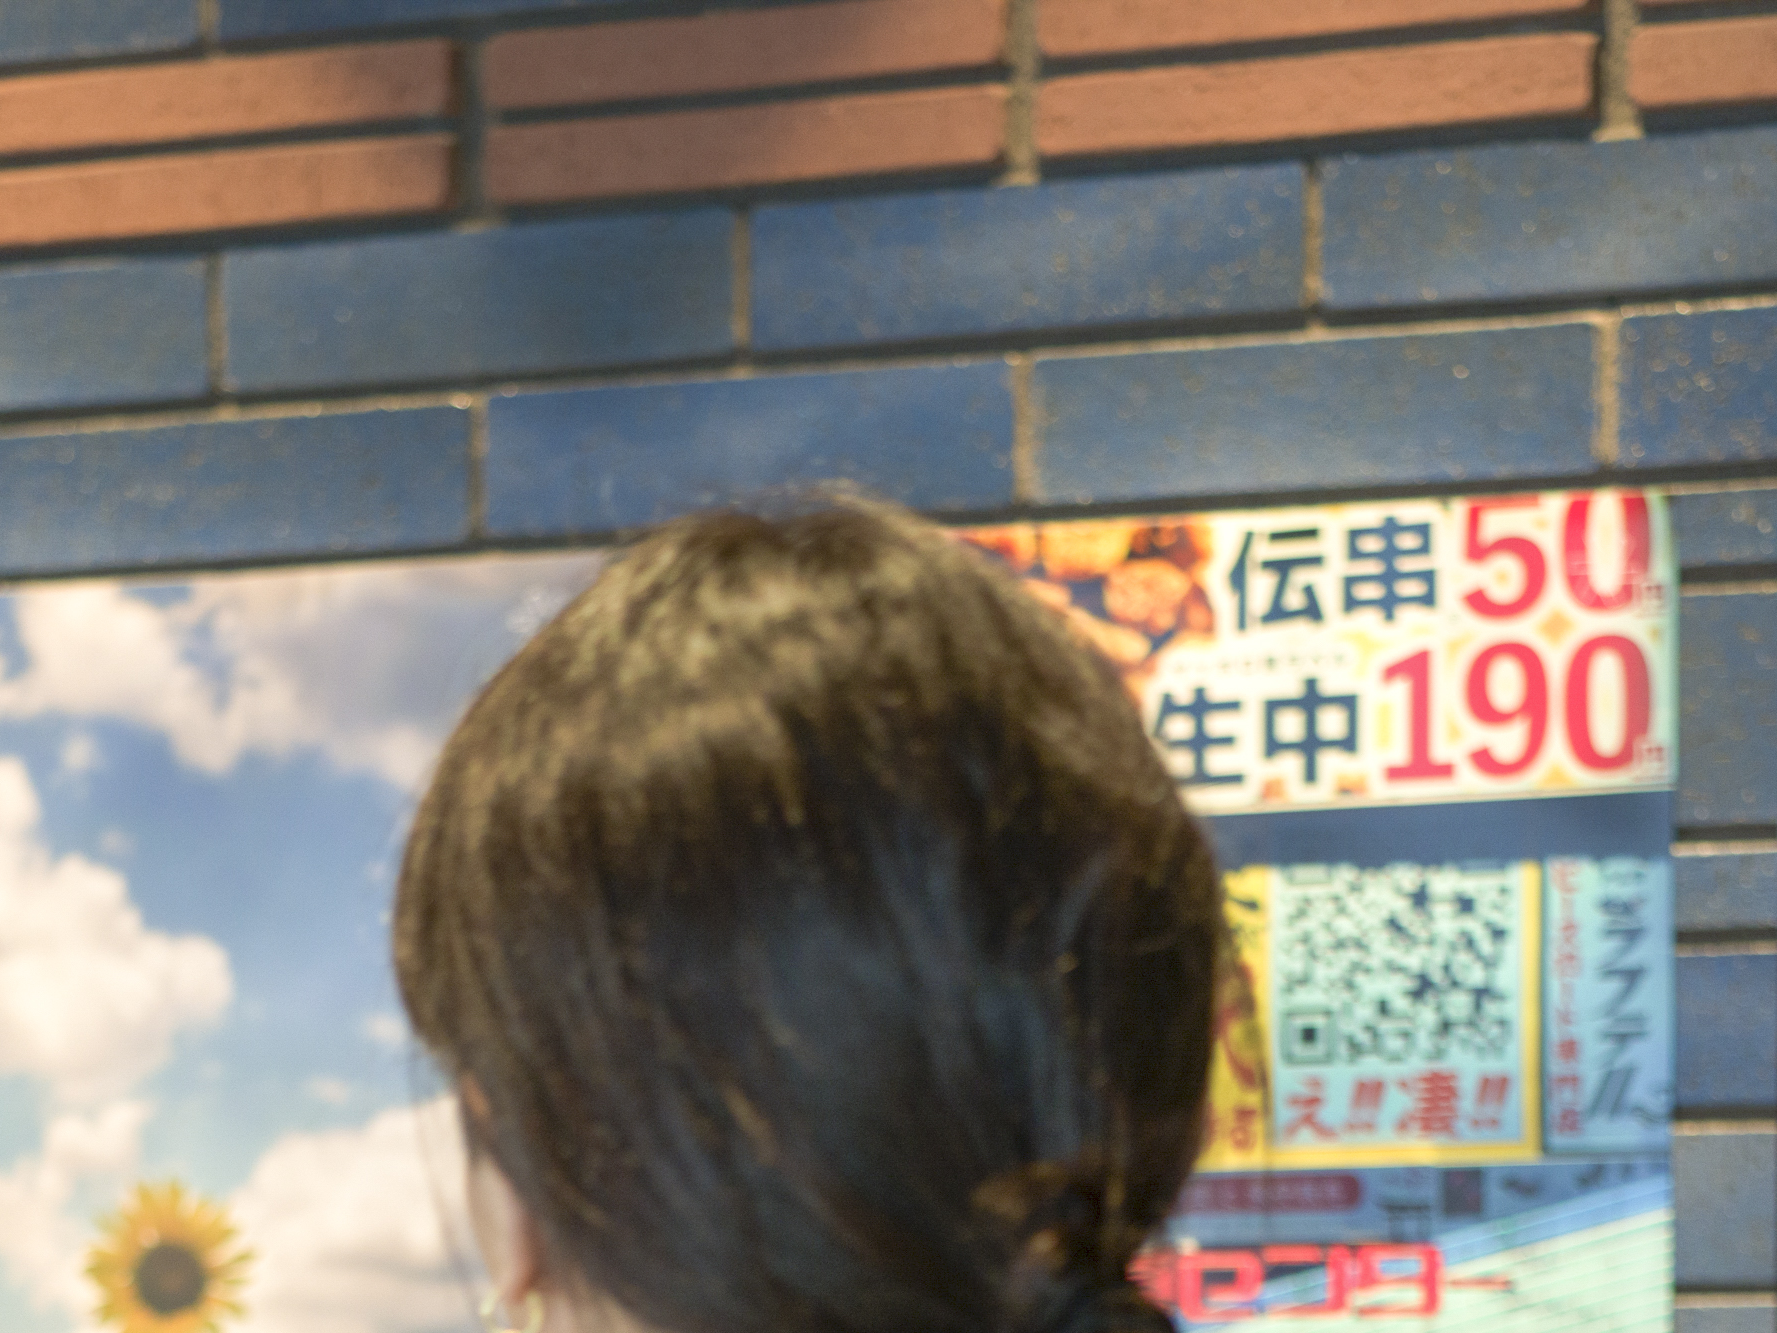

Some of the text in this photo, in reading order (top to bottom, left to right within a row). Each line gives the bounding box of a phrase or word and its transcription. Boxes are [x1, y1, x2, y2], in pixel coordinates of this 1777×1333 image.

[1229, 516, 1438, 631] 伝串
[1153, 678, 1359, 785] 生中
[1381, 635, 1651, 783] 190
